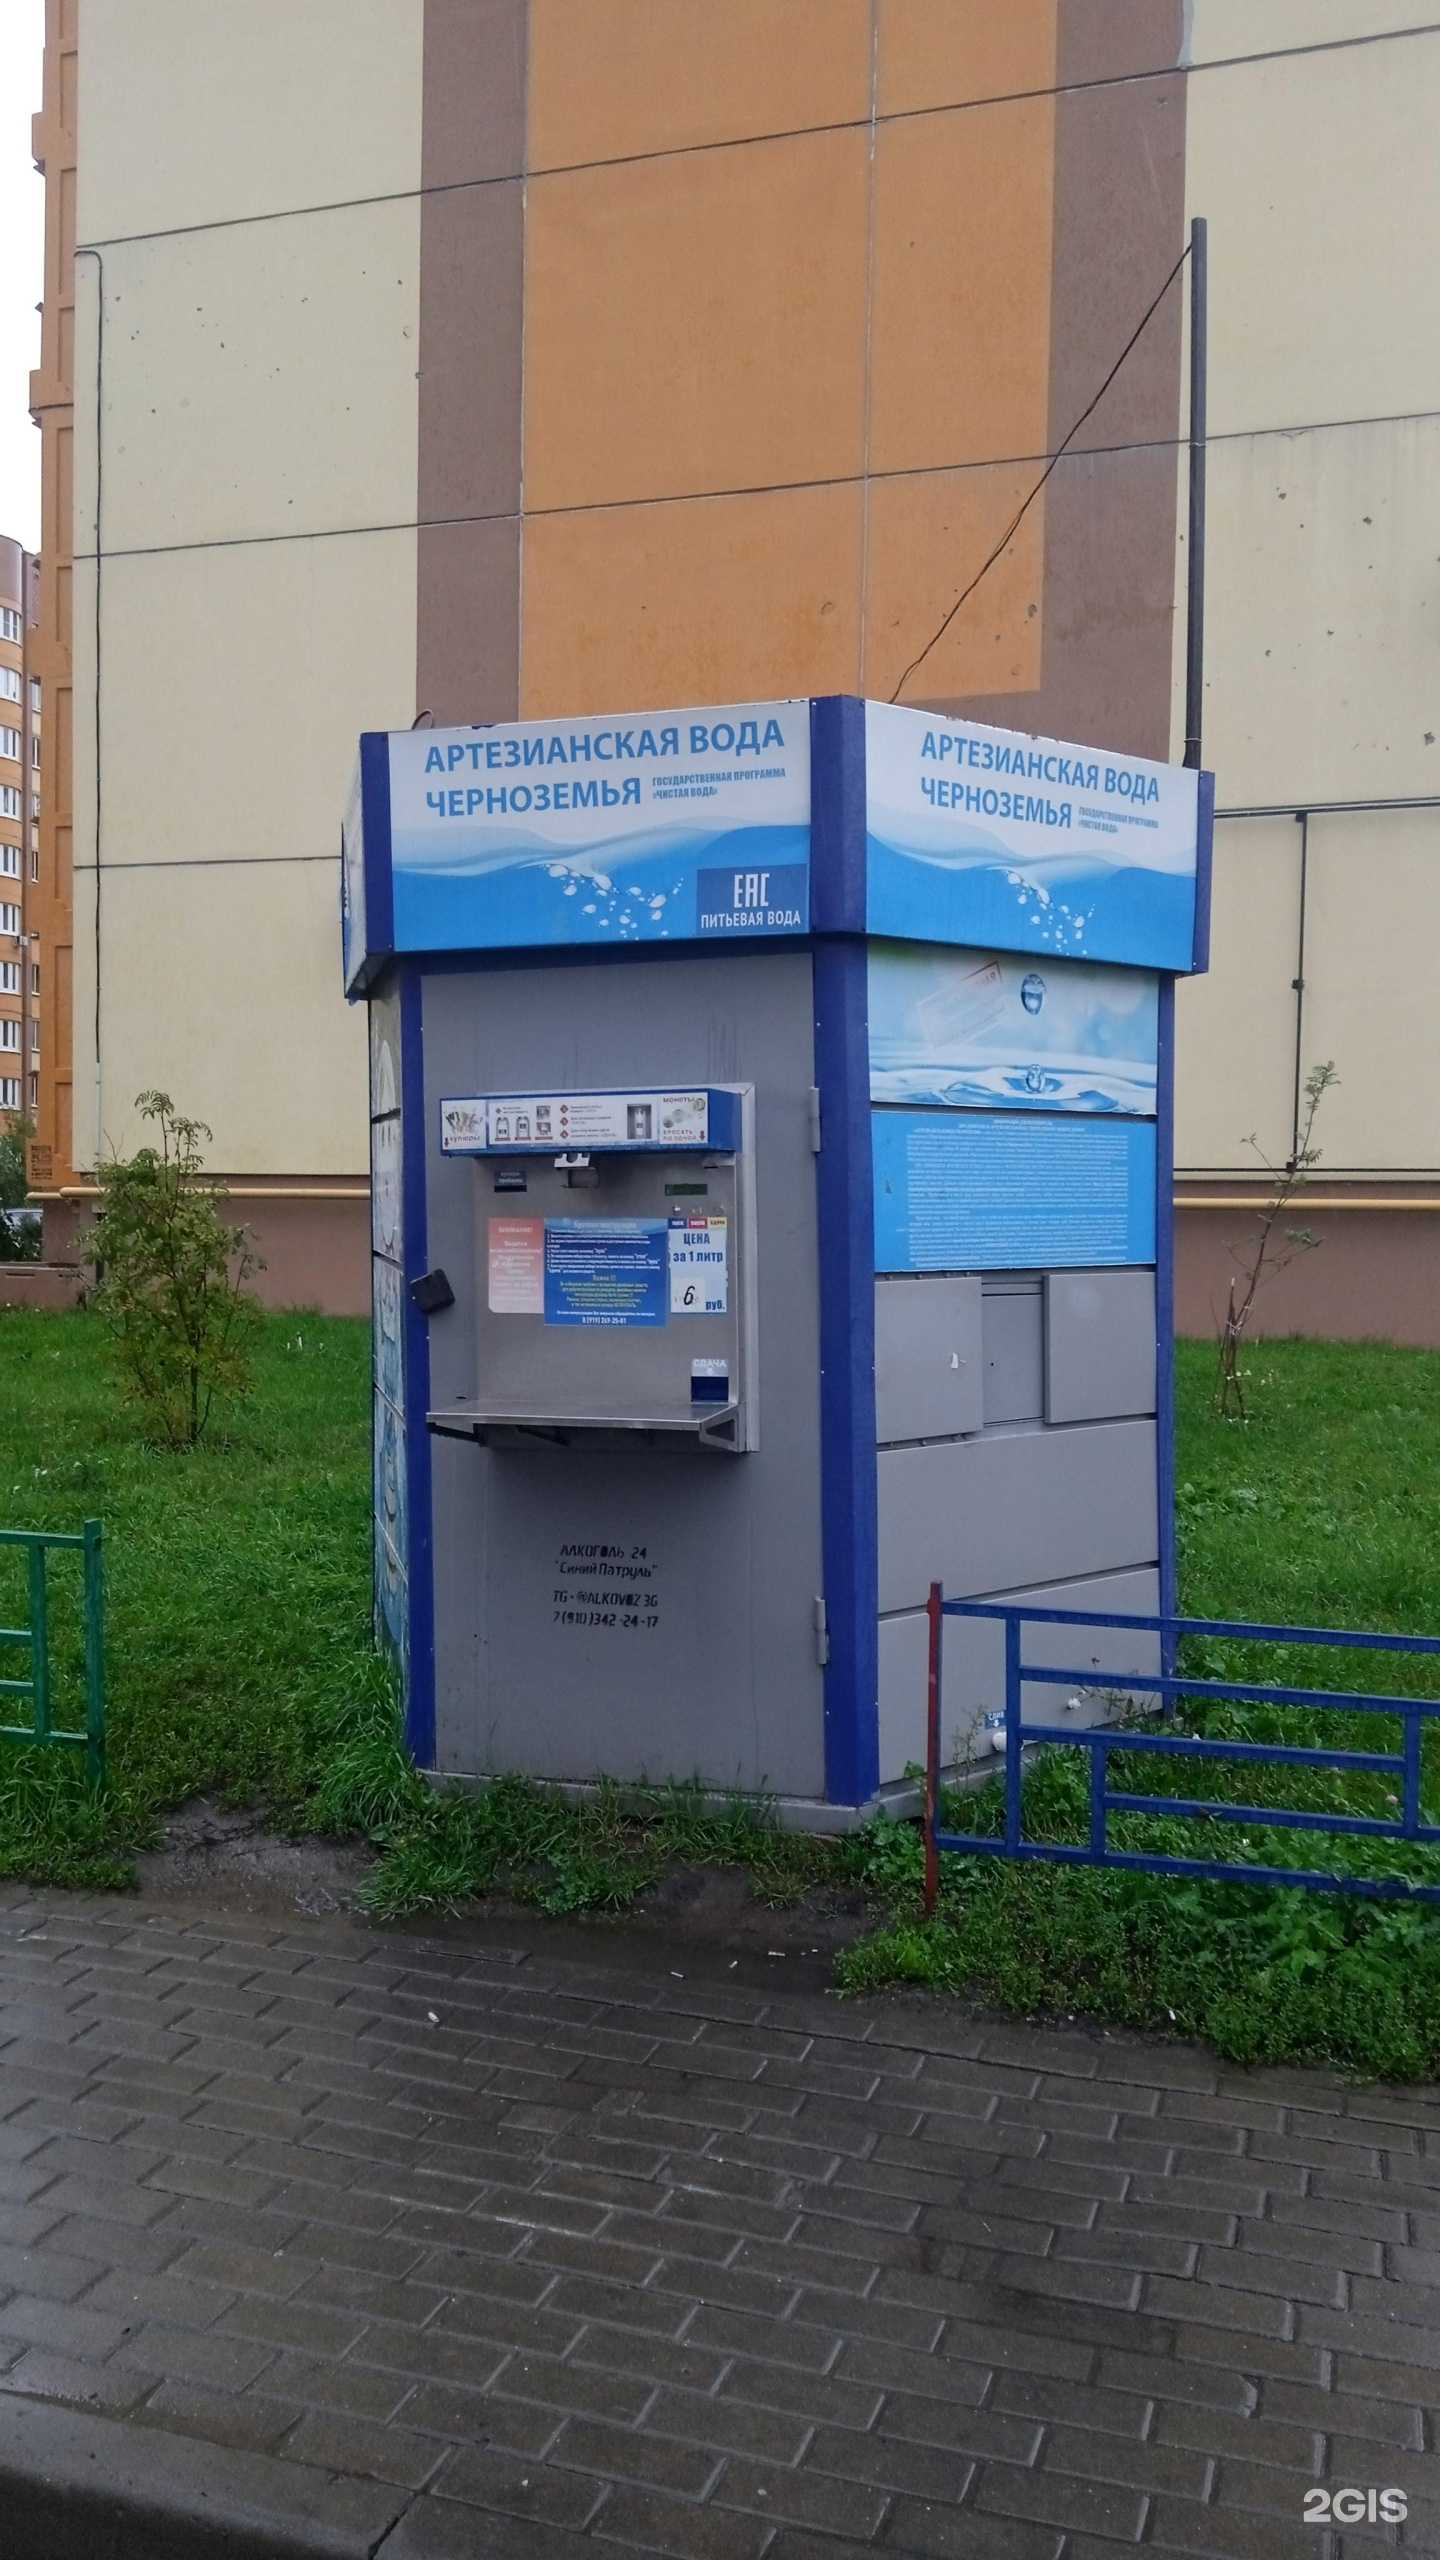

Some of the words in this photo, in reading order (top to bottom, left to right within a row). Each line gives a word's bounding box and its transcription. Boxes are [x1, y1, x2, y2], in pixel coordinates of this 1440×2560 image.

[425, 726, 679, 773] АРТЕЗИАНСКАЯ
[690, 719, 785, 756] ВОДА
[652, 772, 733, 786] ГОСУДАРСТВЕННАЯ
[734, 768, 786, 780] ПРОГРАММА
[921, 731, 1098, 791] АРТЕЗИАНСКАЯ
[1104, 767, 1159, 805] ВОДА
[426, 777, 641, 817] ЧЕРНОЗЕМЬЯ
[921, 776, 1072, 829] ЧЕРНОЗЕМЬЯ
[701, 912, 763, 929] ПИТЬЕВАЯ
[767, 910, 801, 927] ВОДА
[683, 1232, 710, 1246] ЦЕНА
[673, 1252, 686, 1263] за
[688, 1250, 694, 1263] 1
[696, 1252, 724, 1263] литр
[683, 1285, 696, 1306] 6
[705, 1299, 726, 1311] руб.
[560, 1544, 625, 1559] АЛКОГОЛЬ
[631, 1546, 648, 1560] 24
